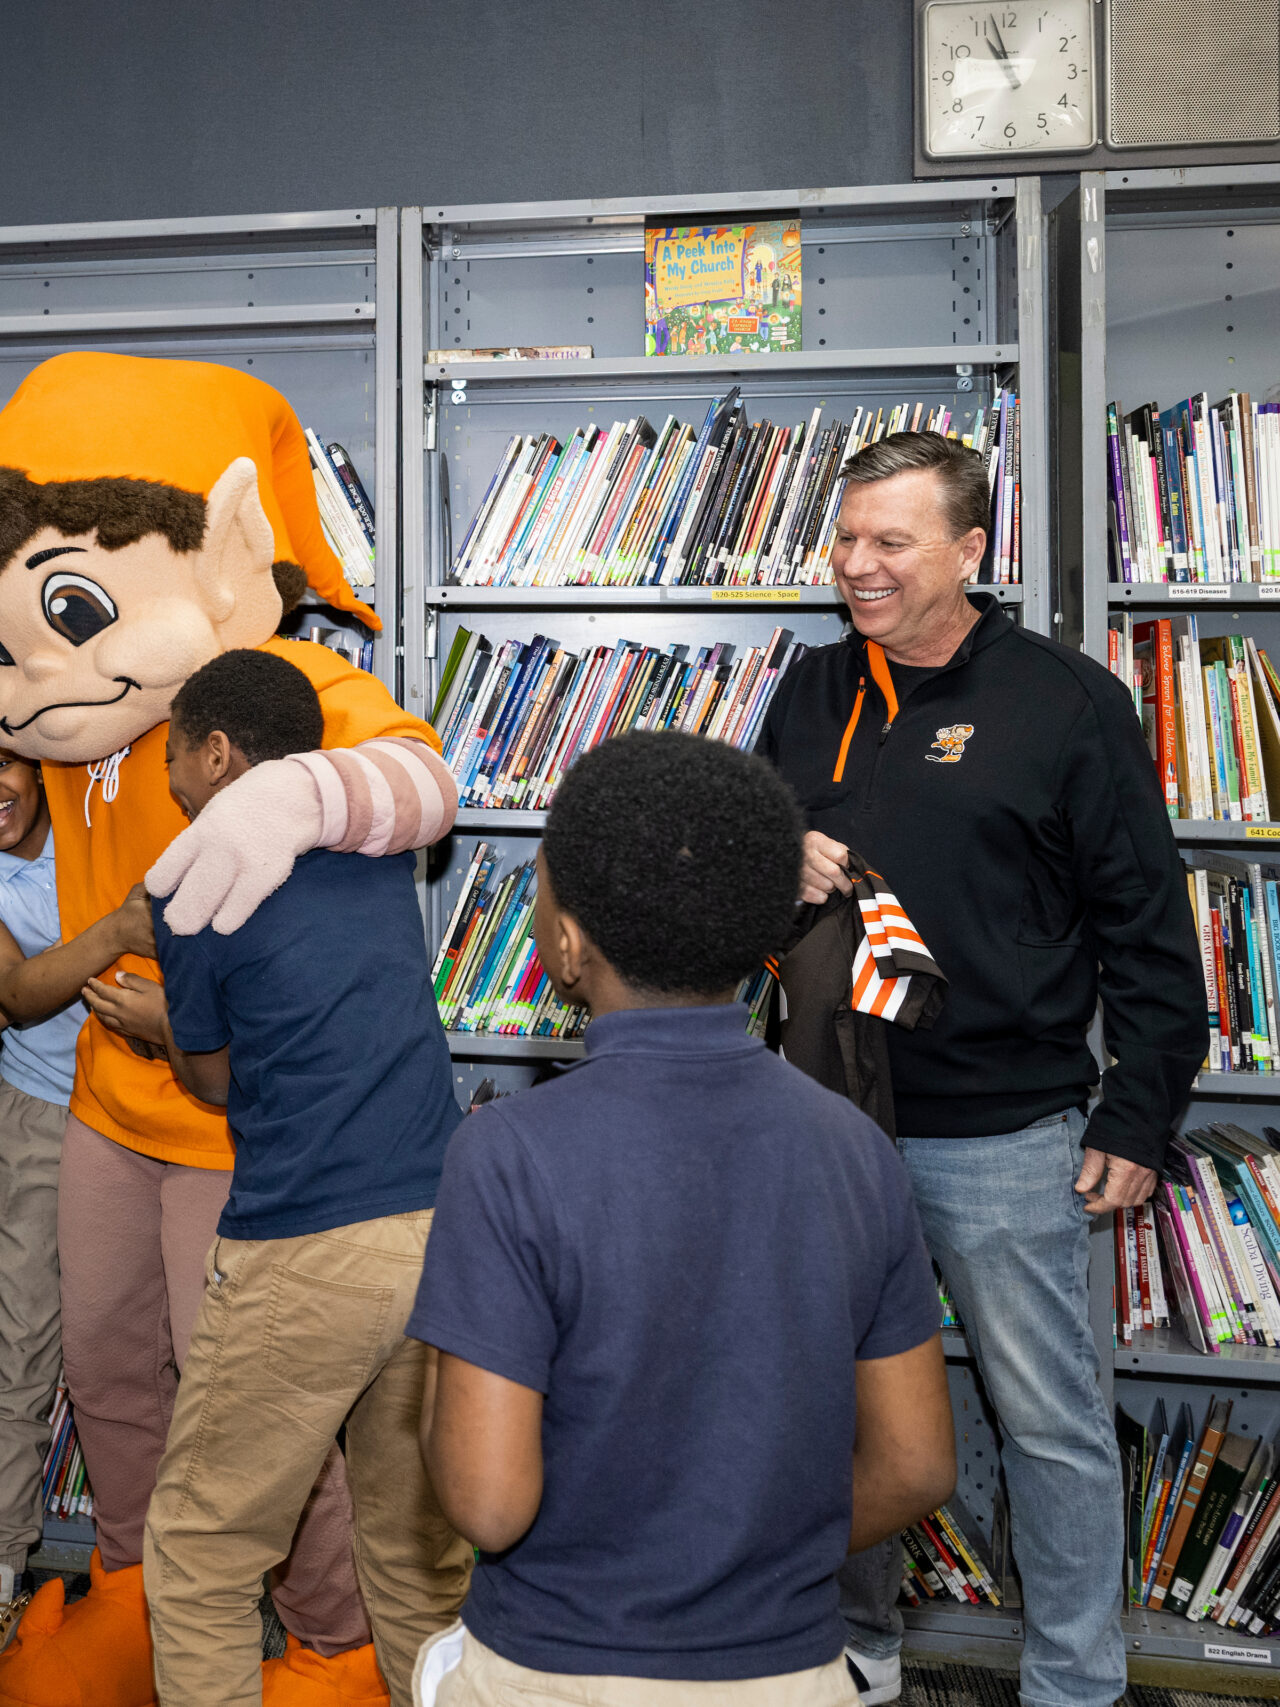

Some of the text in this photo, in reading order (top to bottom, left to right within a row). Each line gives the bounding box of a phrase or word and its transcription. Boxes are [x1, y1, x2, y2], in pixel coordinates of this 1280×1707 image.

[975, 20, 987, 36] 11
[1002, 12, 1017, 28] 12
[950, 45, 971, 60] 10
[1059, 37, 1069, 53] 2
[942, 70, 955, 87] 9
[1067, 64, 1078, 80] 3
[952, 97, 963, 113] 8
[1057, 93, 1069, 108] 4
[975, 116, 985, 131] 7
[1037, 113, 1047, 128] 5
[1003, 122, 1016, 138] 6
[662, 240, 736, 262] A Peek Into
[667, 258, 735, 280] My Church
[721, 426, 733, 444] STARS
[1004, 408, 1014, 476] EYEWITNESS BOOKS
[709, 449, 725, 475] PLANETS
[1155, 456, 1164, 473] Fighting
[1012, 524, 1020, 559] COMPOUNDS
[745, 591, 772, 599] Science
[777, 591, 799, 600] Space
[532, 645, 540, 655] The
[1159, 644, 1173, 672] Silver
[520, 655, 536, 682] Kingfisher
[513, 682, 524, 697] Young
[640, 657, 669, 716] EYEWITNESS BOOKS
[1160, 673, 1175, 701] Spoon
[504, 696, 518, 719] People's
[1162, 702, 1174, 717] for
[1238, 693, 1251, 718] There's
[464, 718, 481, 749] CRYSTAL
[499, 719, 509, 734] Book
[1242, 724, 1253, 740] Chef
[580, 729, 589, 742] BOOK
[1161, 721, 1176, 758] Children
[1245, 750, 1255, 761] My
[1246, 762, 1259, 788] Family!
[1251, 828, 1266, 836] 641
[460, 889, 479, 923] Our Environment
[501, 876, 527, 927] TEMPERATE FORESTS
[1229, 891, 1237, 903] Piano
[1236, 962, 1244, 975] Frank
[1271, 918, 1279, 931] BIG
[1199, 924, 1213, 957] GREAT
[1136, 1215, 1149, 1283] THE STORY OF BASEBALL
[1238, 1226, 1276, 1301] Scuba Diving
[1221, 1649, 1244, 1658] English
[1246, 1651, 1268, 1660] Drama
